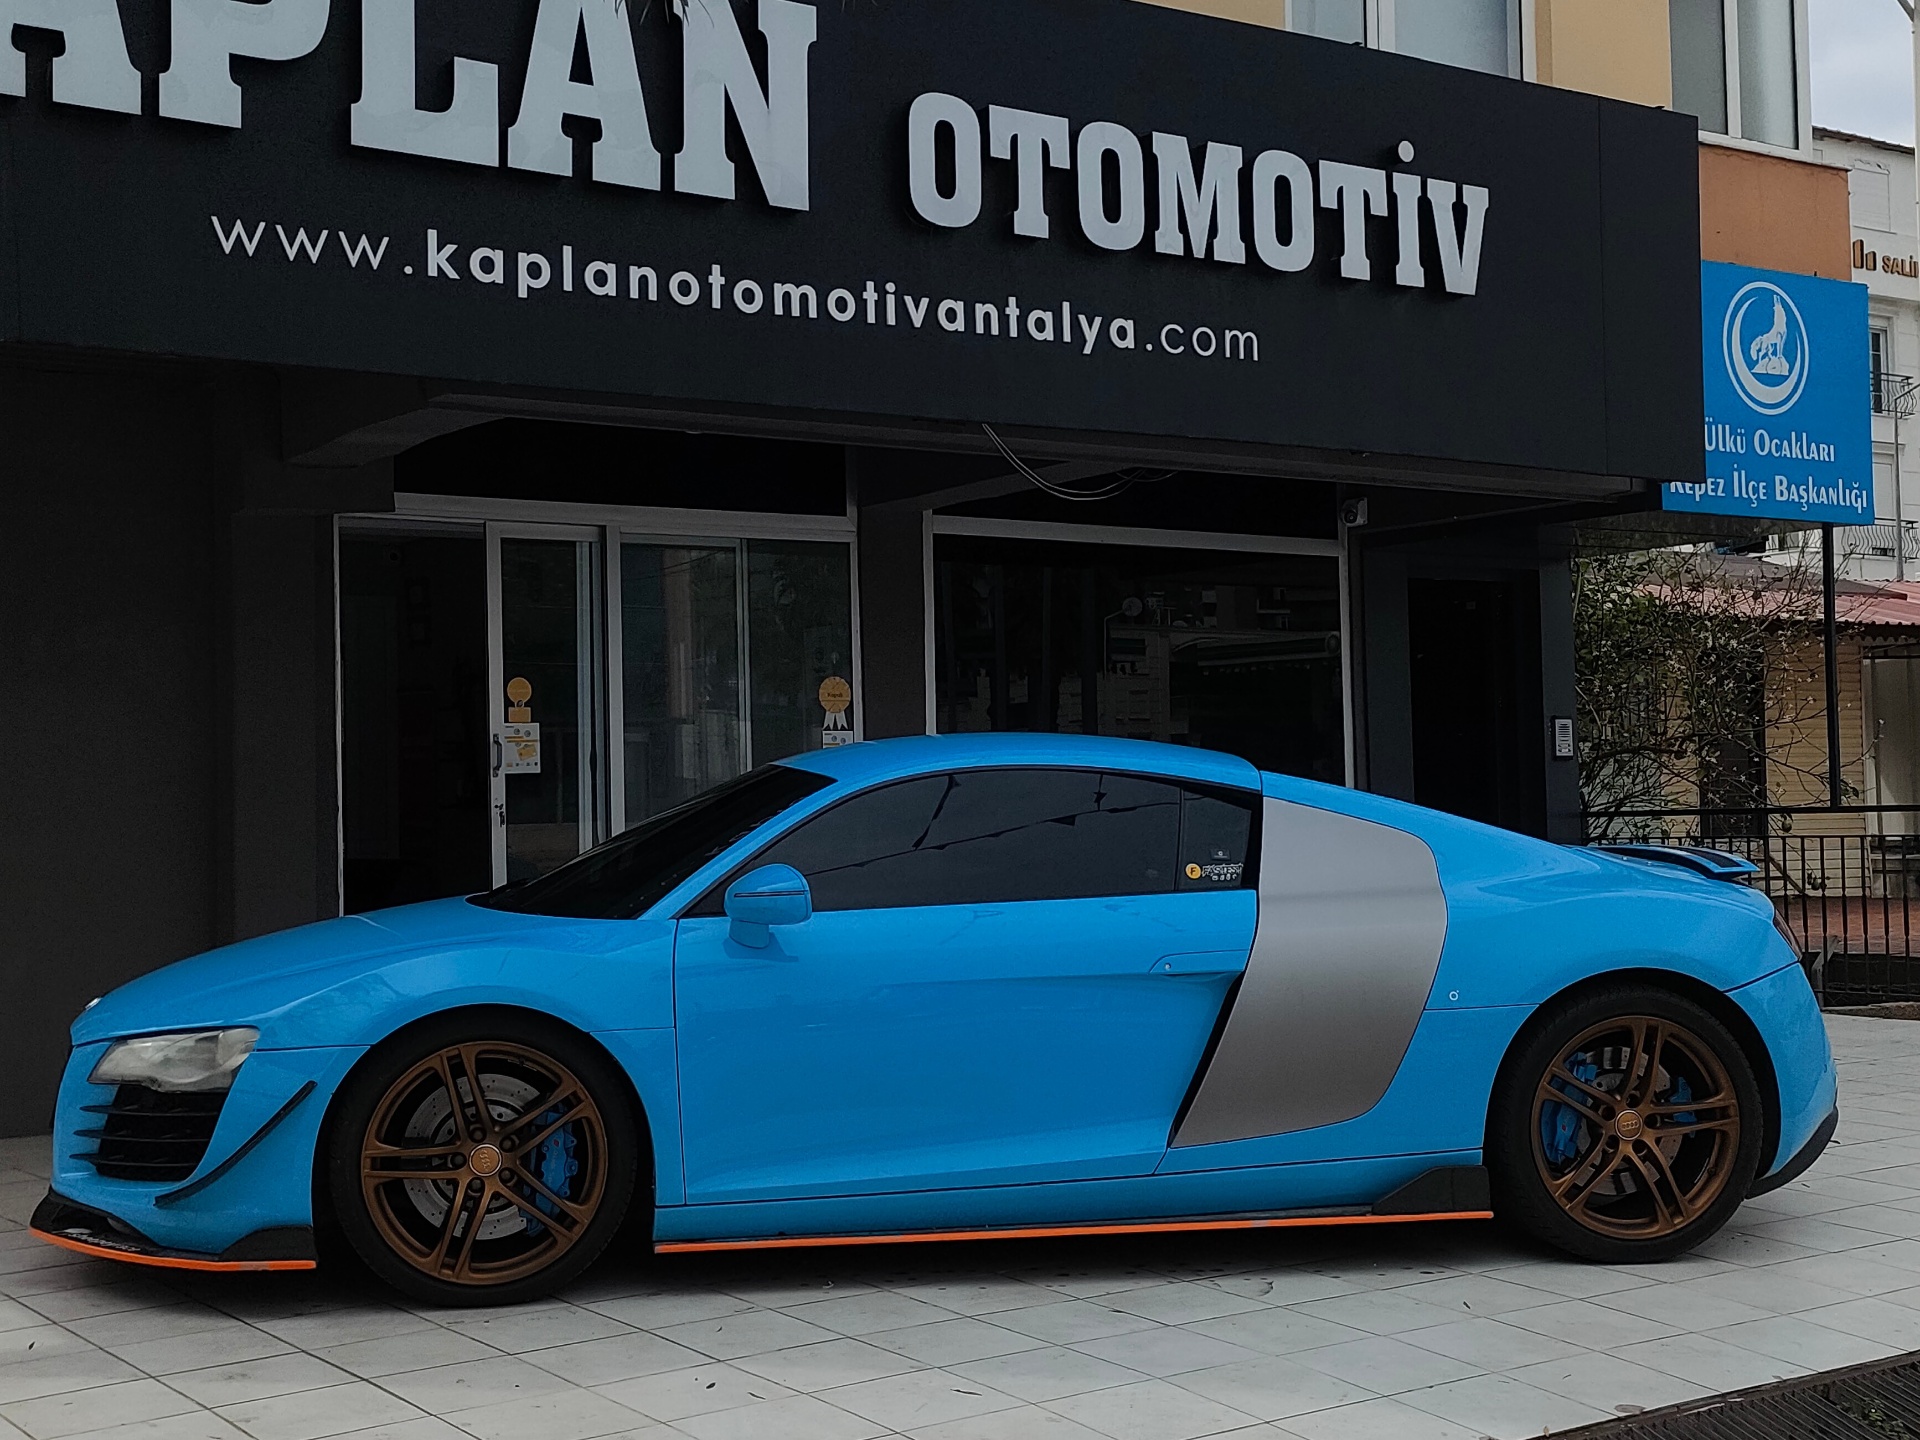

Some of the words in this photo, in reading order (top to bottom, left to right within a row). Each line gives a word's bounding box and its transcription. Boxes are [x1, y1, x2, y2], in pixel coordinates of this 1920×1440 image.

[908, 91, 1489, 295] OTOMOTİV
[211, 215, 1260, 362] www.kaplanotomotivantalya.com
[1704, 416, 1746, 454] Ülkü
[1732, 463, 1767, 507] İlçe
[1774, 475, 1867, 514] Başkanlığı
